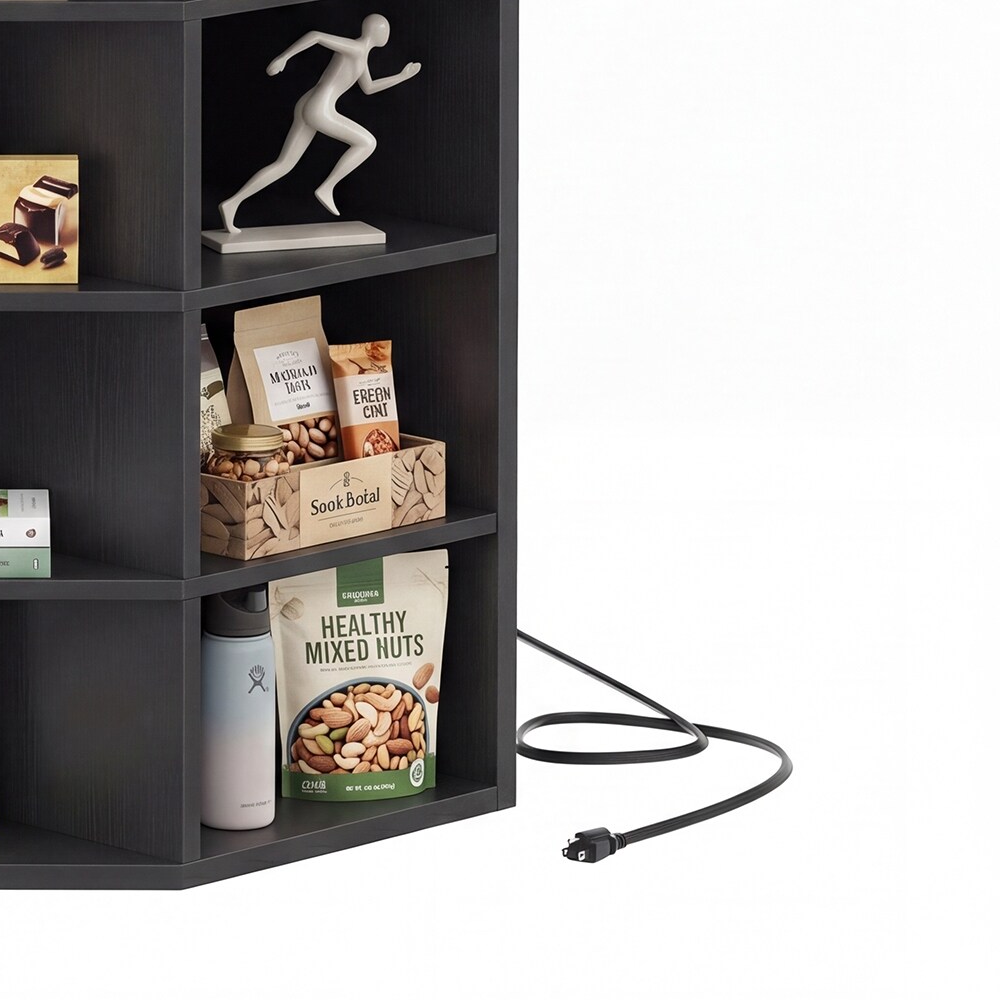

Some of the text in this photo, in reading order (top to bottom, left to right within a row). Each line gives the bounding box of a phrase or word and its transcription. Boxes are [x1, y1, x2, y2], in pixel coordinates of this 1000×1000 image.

[311, 495, 344, 516] Sook
[321, 610, 407, 639] HEALTHY
[305, 634, 424, 665] MIXED NUTS
